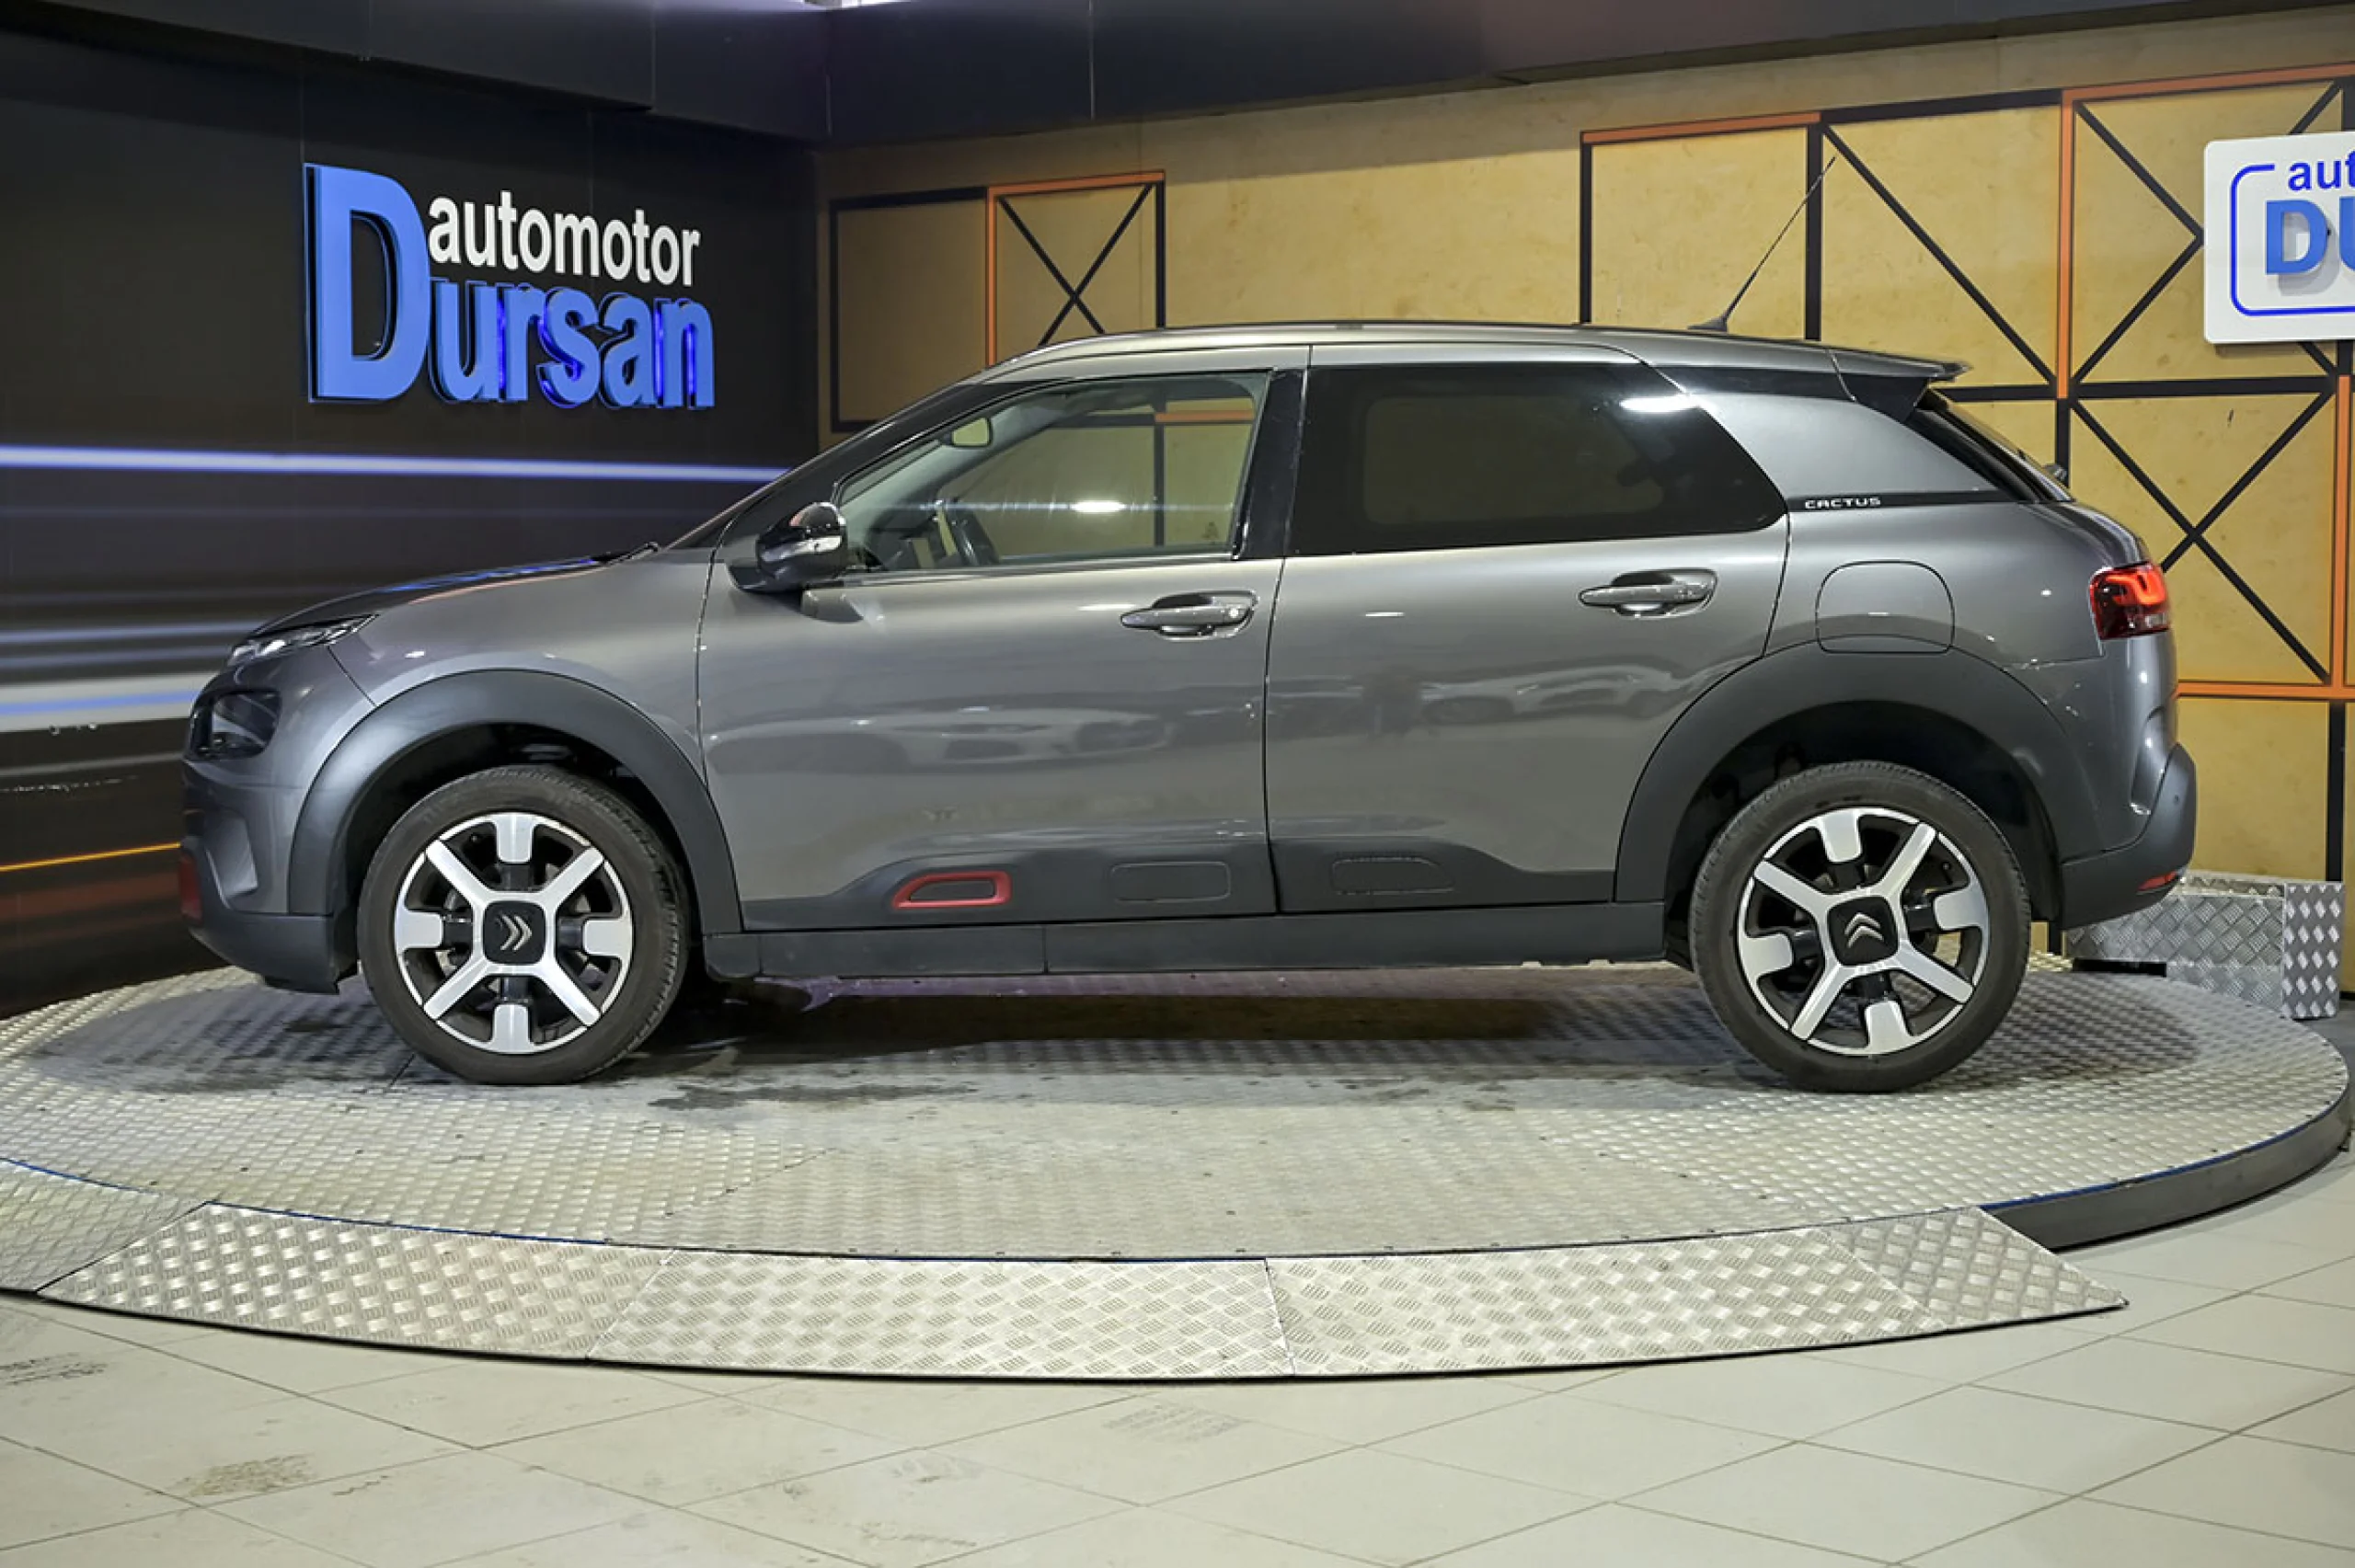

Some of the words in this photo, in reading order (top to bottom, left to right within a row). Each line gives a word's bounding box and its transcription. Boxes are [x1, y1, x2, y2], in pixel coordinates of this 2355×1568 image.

[304, 162, 716, 408] Dursan
[428, 189, 701, 287] automotor
[1804, 497, 1881, 509] CACTUS
